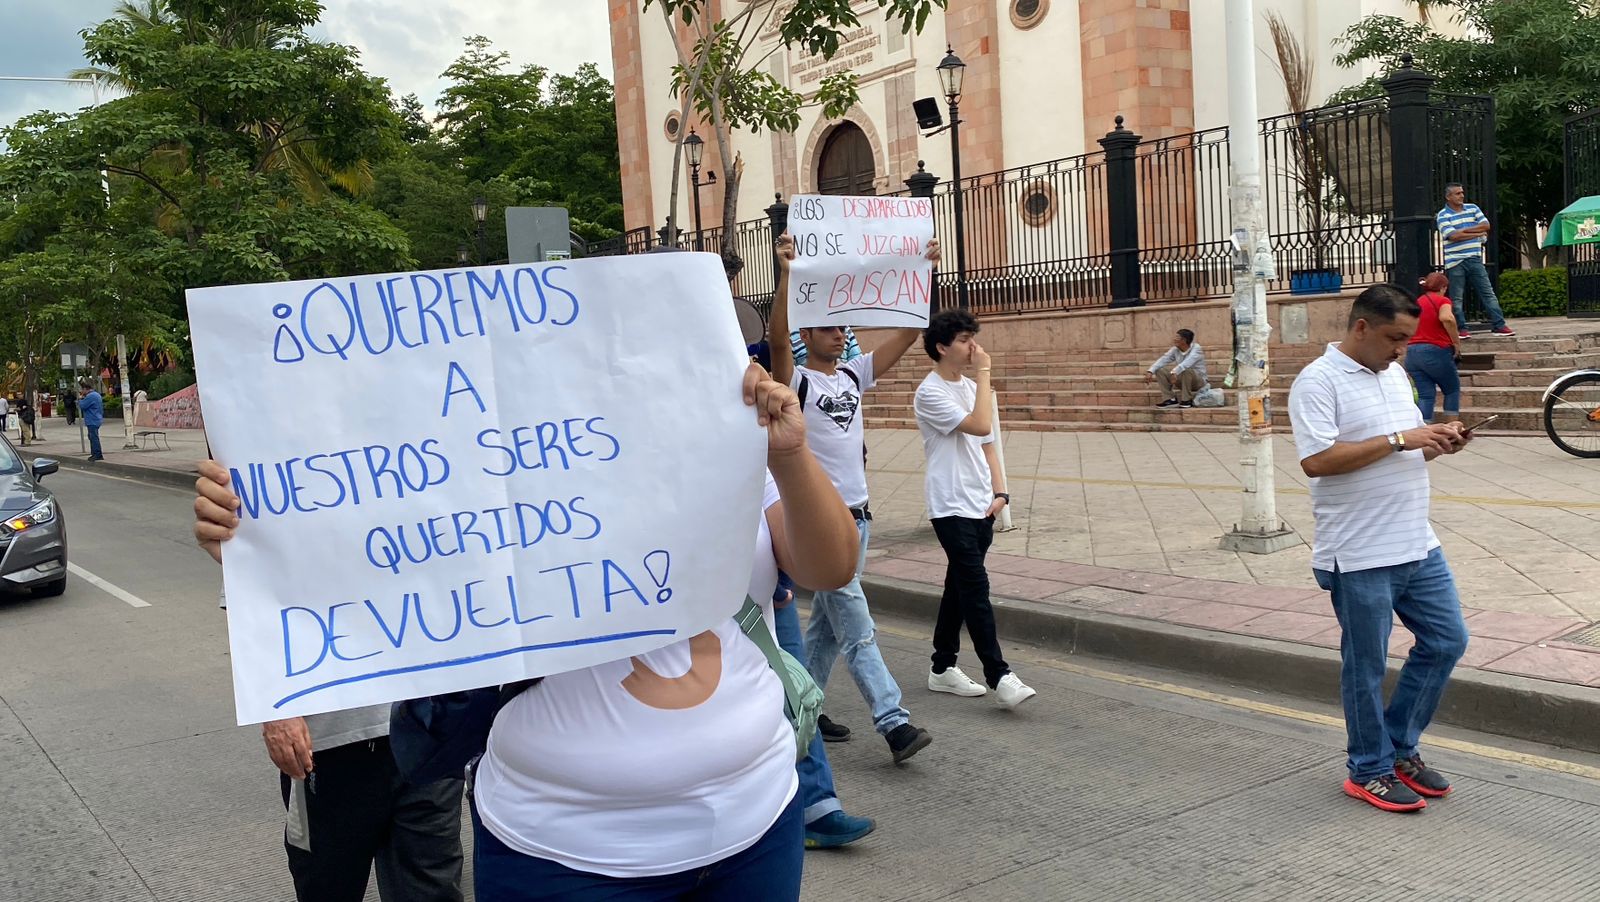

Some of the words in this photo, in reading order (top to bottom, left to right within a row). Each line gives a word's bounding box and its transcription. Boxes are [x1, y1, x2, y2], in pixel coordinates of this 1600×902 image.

[843, 198, 932, 218] DESAPARECIDOS
[793, 232, 818, 257] NO
[825, 232, 846, 256] SE
[273, 266, 579, 363] ¡QUEREMOS
[796, 282, 818, 305] SE
[828, 269, 931, 309] BUSCAN
[442, 361, 486, 417] A
[230, 438, 450, 519] NUESTROS
[476, 417, 620, 477] SERES
[365, 496, 601, 574] QUERIDOS
[281, 549, 672, 677] DEVUELTA!
